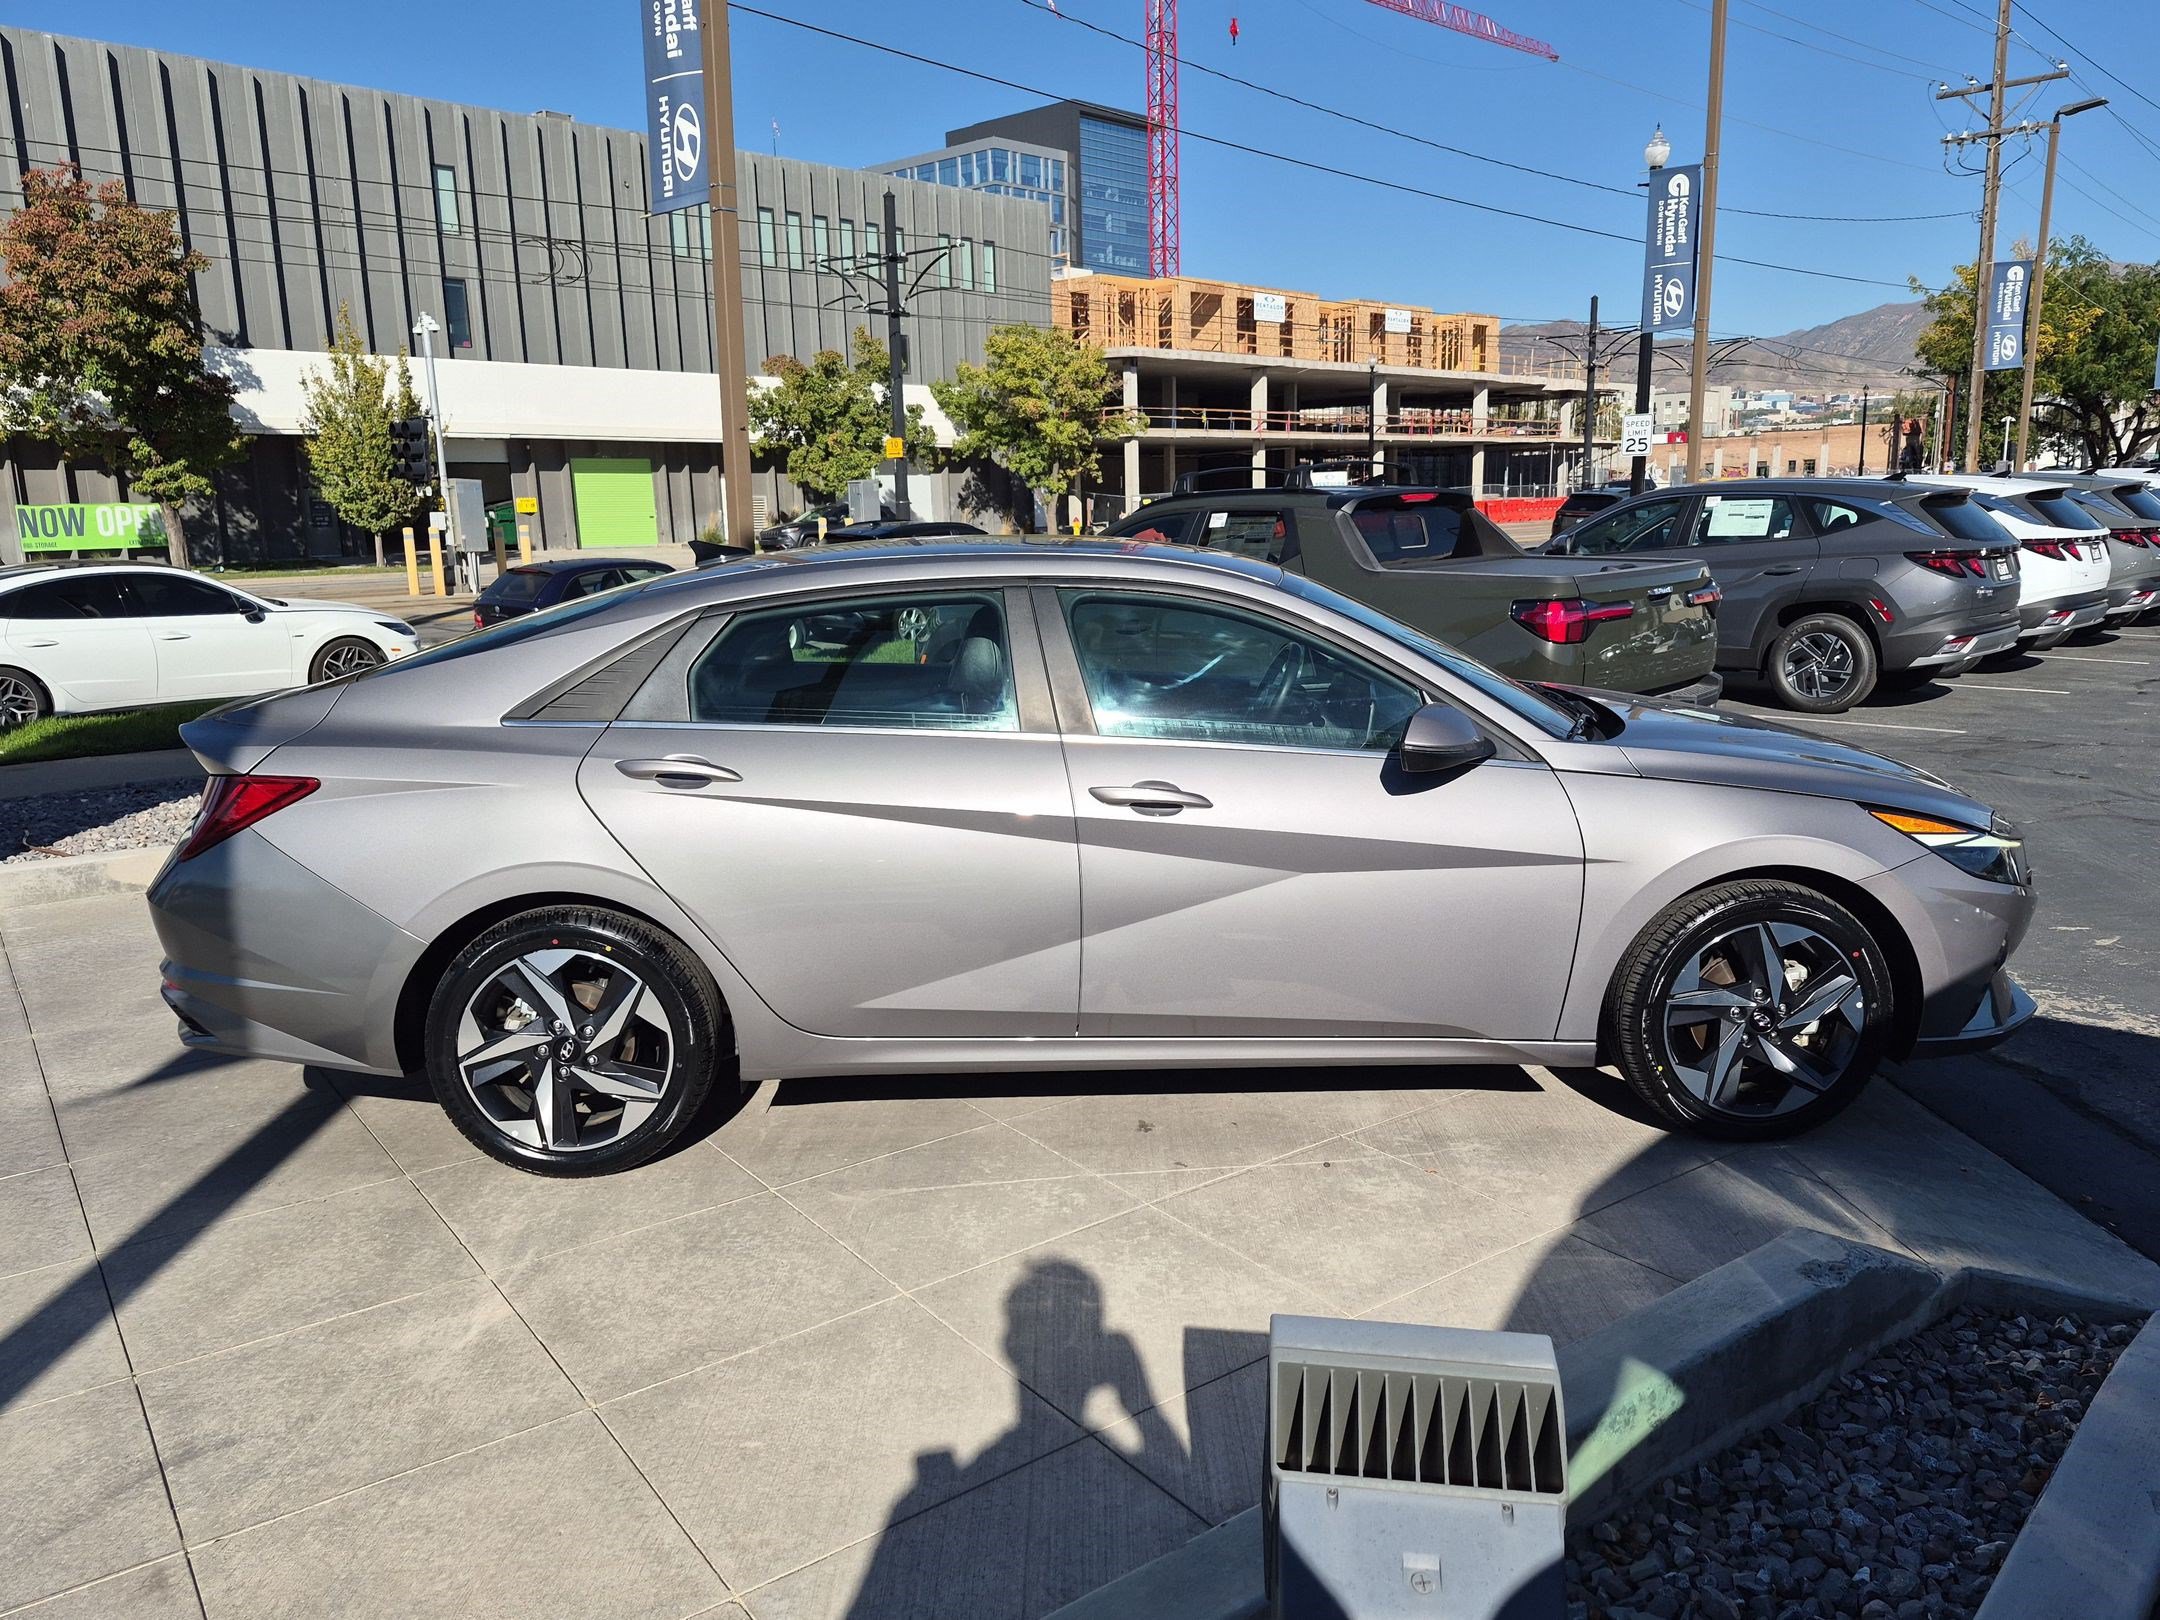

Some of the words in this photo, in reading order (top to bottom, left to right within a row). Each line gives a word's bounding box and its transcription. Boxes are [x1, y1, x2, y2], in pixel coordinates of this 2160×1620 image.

[659, 96, 673, 197] HYUNDAI
[1656, 200, 1665, 246] DOWNTOWN
[1678, 196, 1689, 218] Ken
[1664, 198, 1678, 257] Hyundai
[1677, 218, 1689, 244] Garff
[1652, 274, 1663, 326] HYUNDAI
[2003, 282, 2013, 320] Hyundai
[1992, 331, 2002, 366] HYUNDAI
[1625, 420, 1650, 428] SPEED
[1625, 437, 1648, 452] 25
[17, 507, 85, 539] NOW
[96, 505, 166, 537] OPEN
